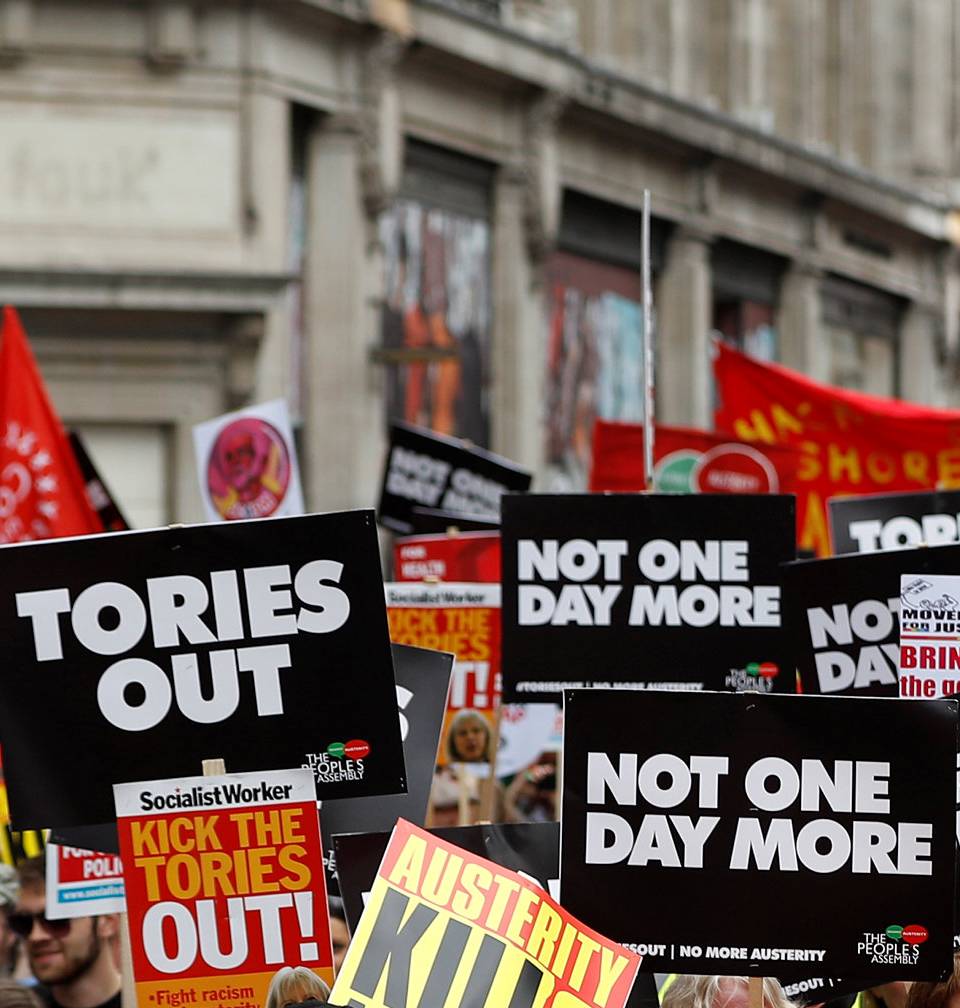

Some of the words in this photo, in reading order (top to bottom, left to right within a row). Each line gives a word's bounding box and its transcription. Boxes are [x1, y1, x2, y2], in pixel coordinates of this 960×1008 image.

[517, 539, 628, 581] NOT
[638, 539, 750, 581] ONE
[15, 560, 350, 662] TORIES
[518, 585, 622, 626] DAY
[629, 586, 781, 627] MORE
[97, 644, 292, 731] OUT
[901, 675, 936, 697] the
[306, 753, 330, 764] THE
[317, 770, 364, 783] ASSEMBLY
[140, 789, 221, 811] Socialist
[222, 782, 292, 803] Worker
[587, 752, 729, 808] NOT
[745, 757, 890, 814] ONE
[130, 816, 220, 856] KICK
[230, 808, 305, 846] THE
[585, 812, 721, 868] DAY
[729, 817, 933, 875] MORE
[134, 845, 312, 901] TORIES
[142, 892, 319, 974] OUT!
[389, 833, 631, 1008] AUSTERITY
[864, 933, 886, 944] THE
[680, 946, 702, 957] NO
[706, 947, 747, 960] MORE
[751, 948, 826, 962] AUSTERITY
[871, 955, 918, 965] ASSEMBLY
[156, 990, 197, 1006] Fight
[202, 987, 254, 1001] racism
